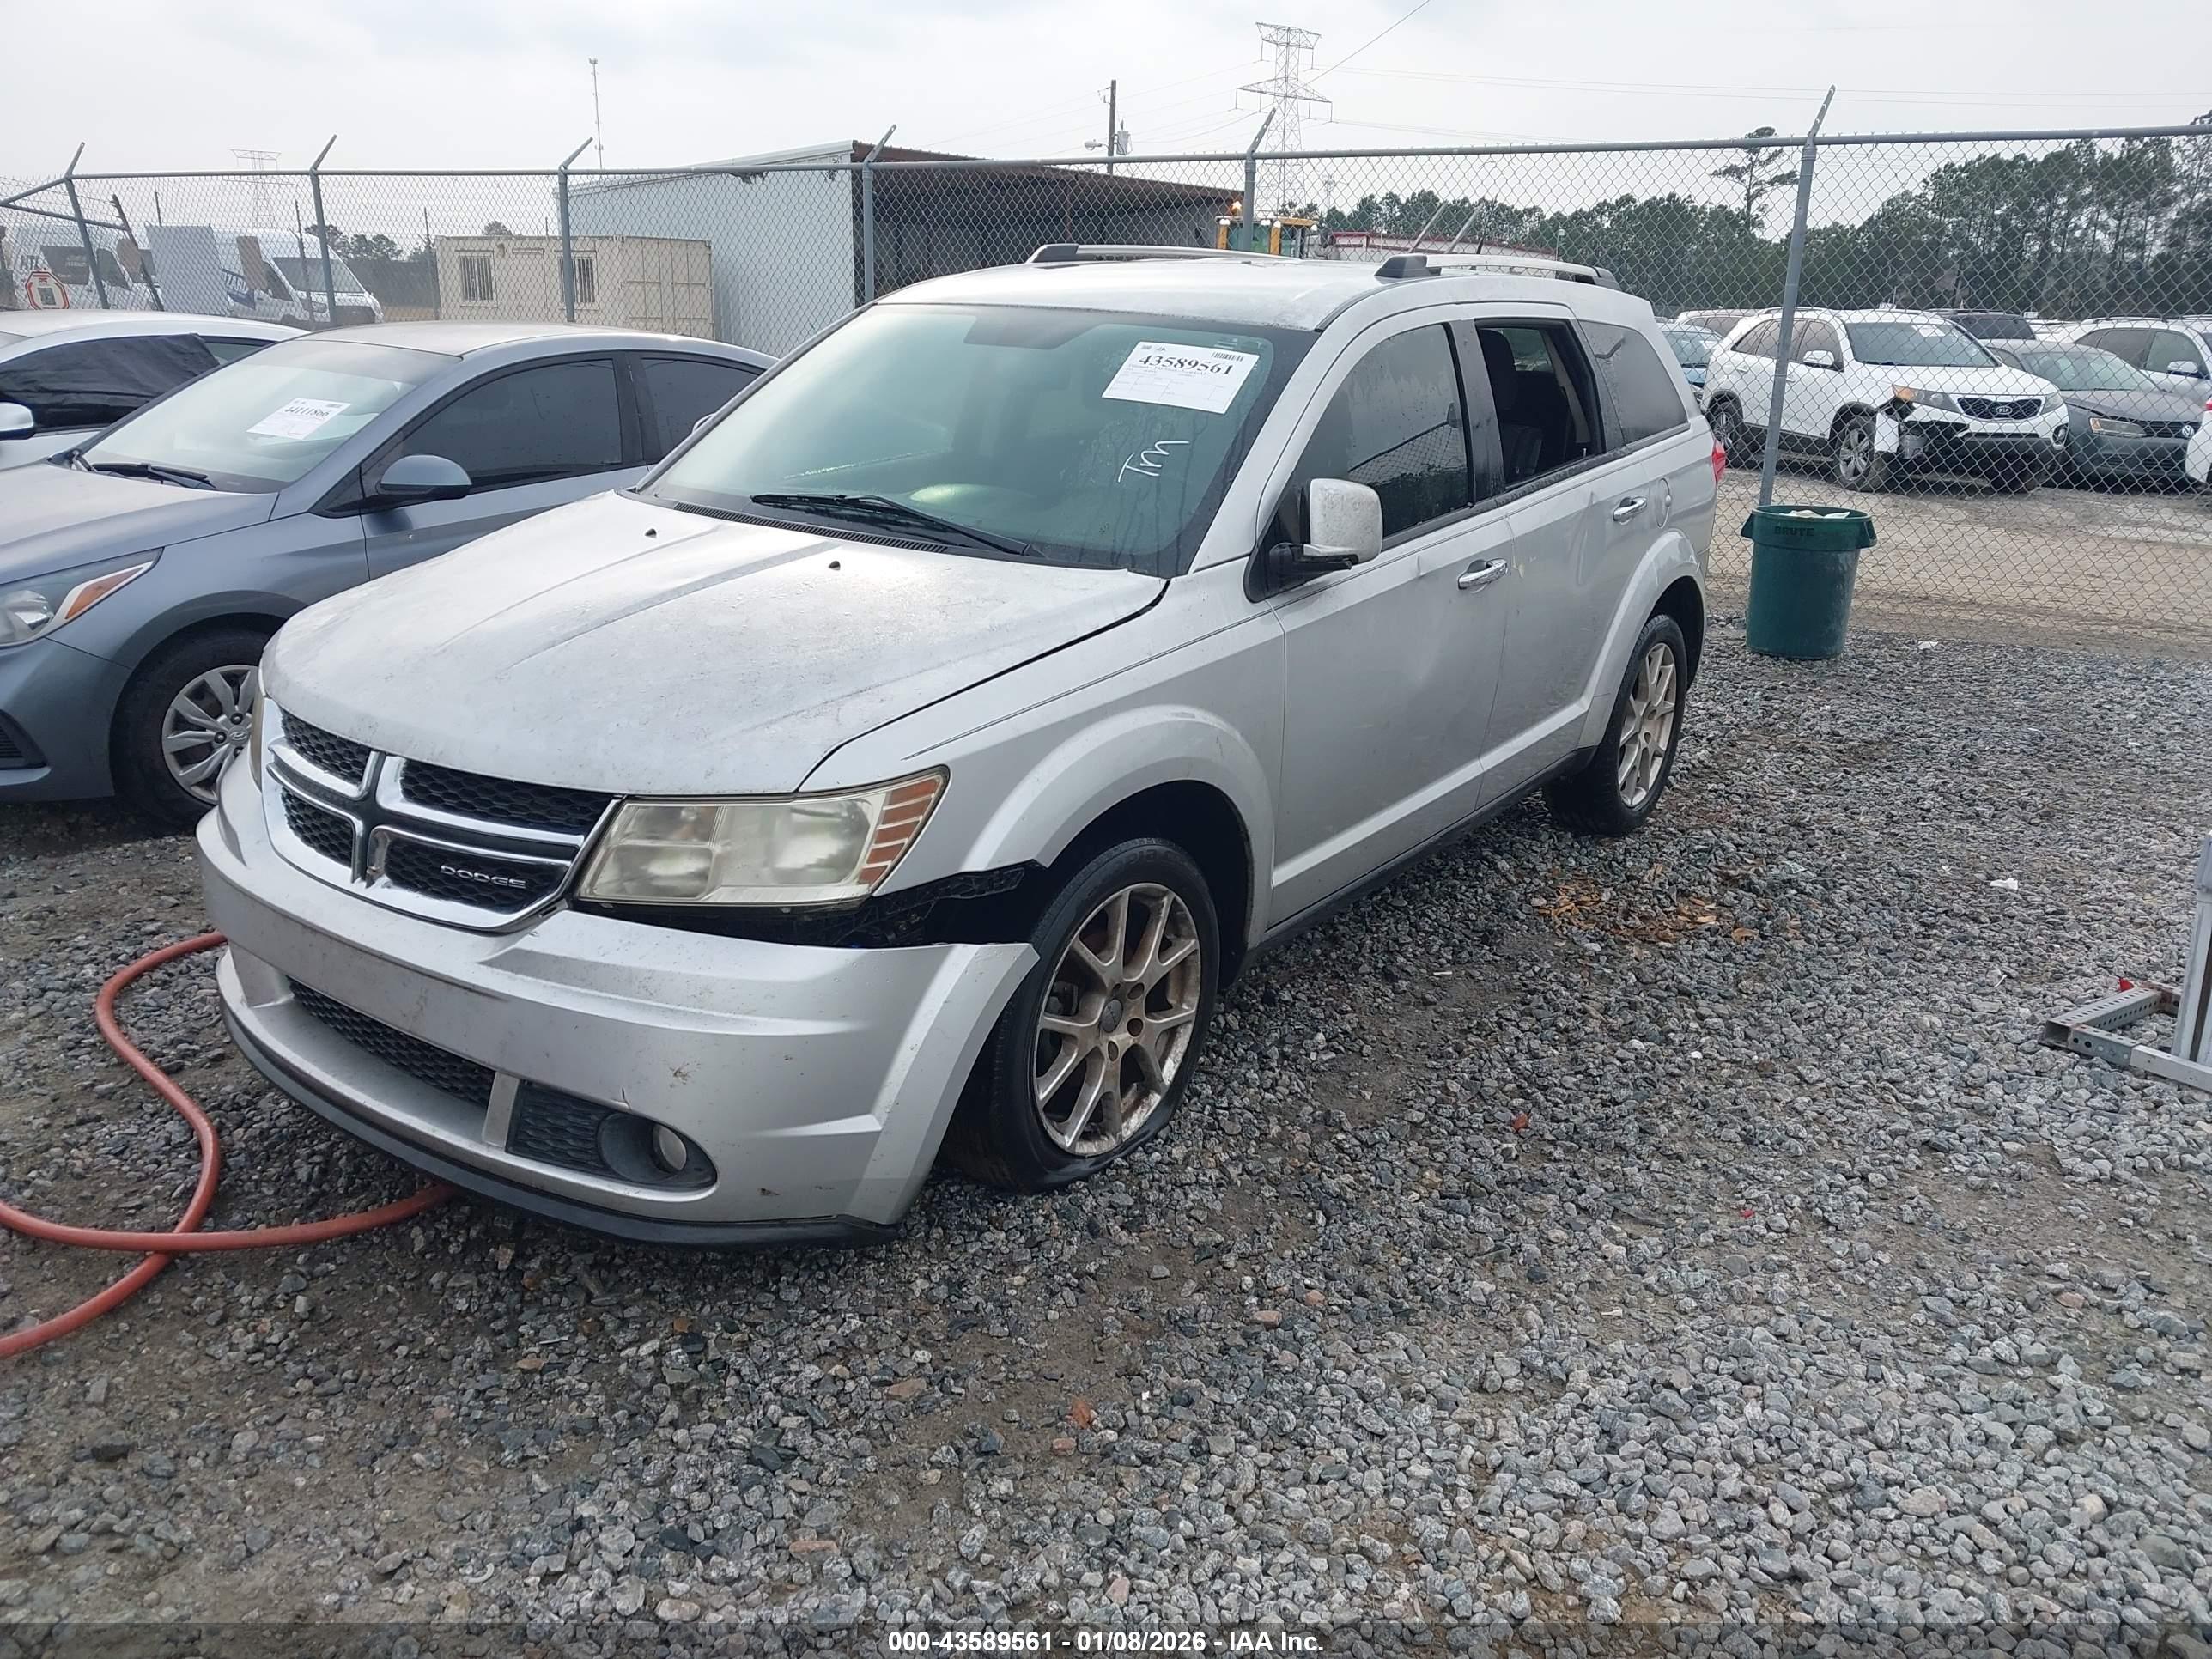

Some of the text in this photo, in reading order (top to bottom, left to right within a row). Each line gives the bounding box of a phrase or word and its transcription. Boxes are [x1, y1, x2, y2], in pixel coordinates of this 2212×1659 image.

[1139, 354, 1233, 375] 43589561
[1774, 526, 1814, 537] BRUTE
[440, 865, 526, 889] DODGE
